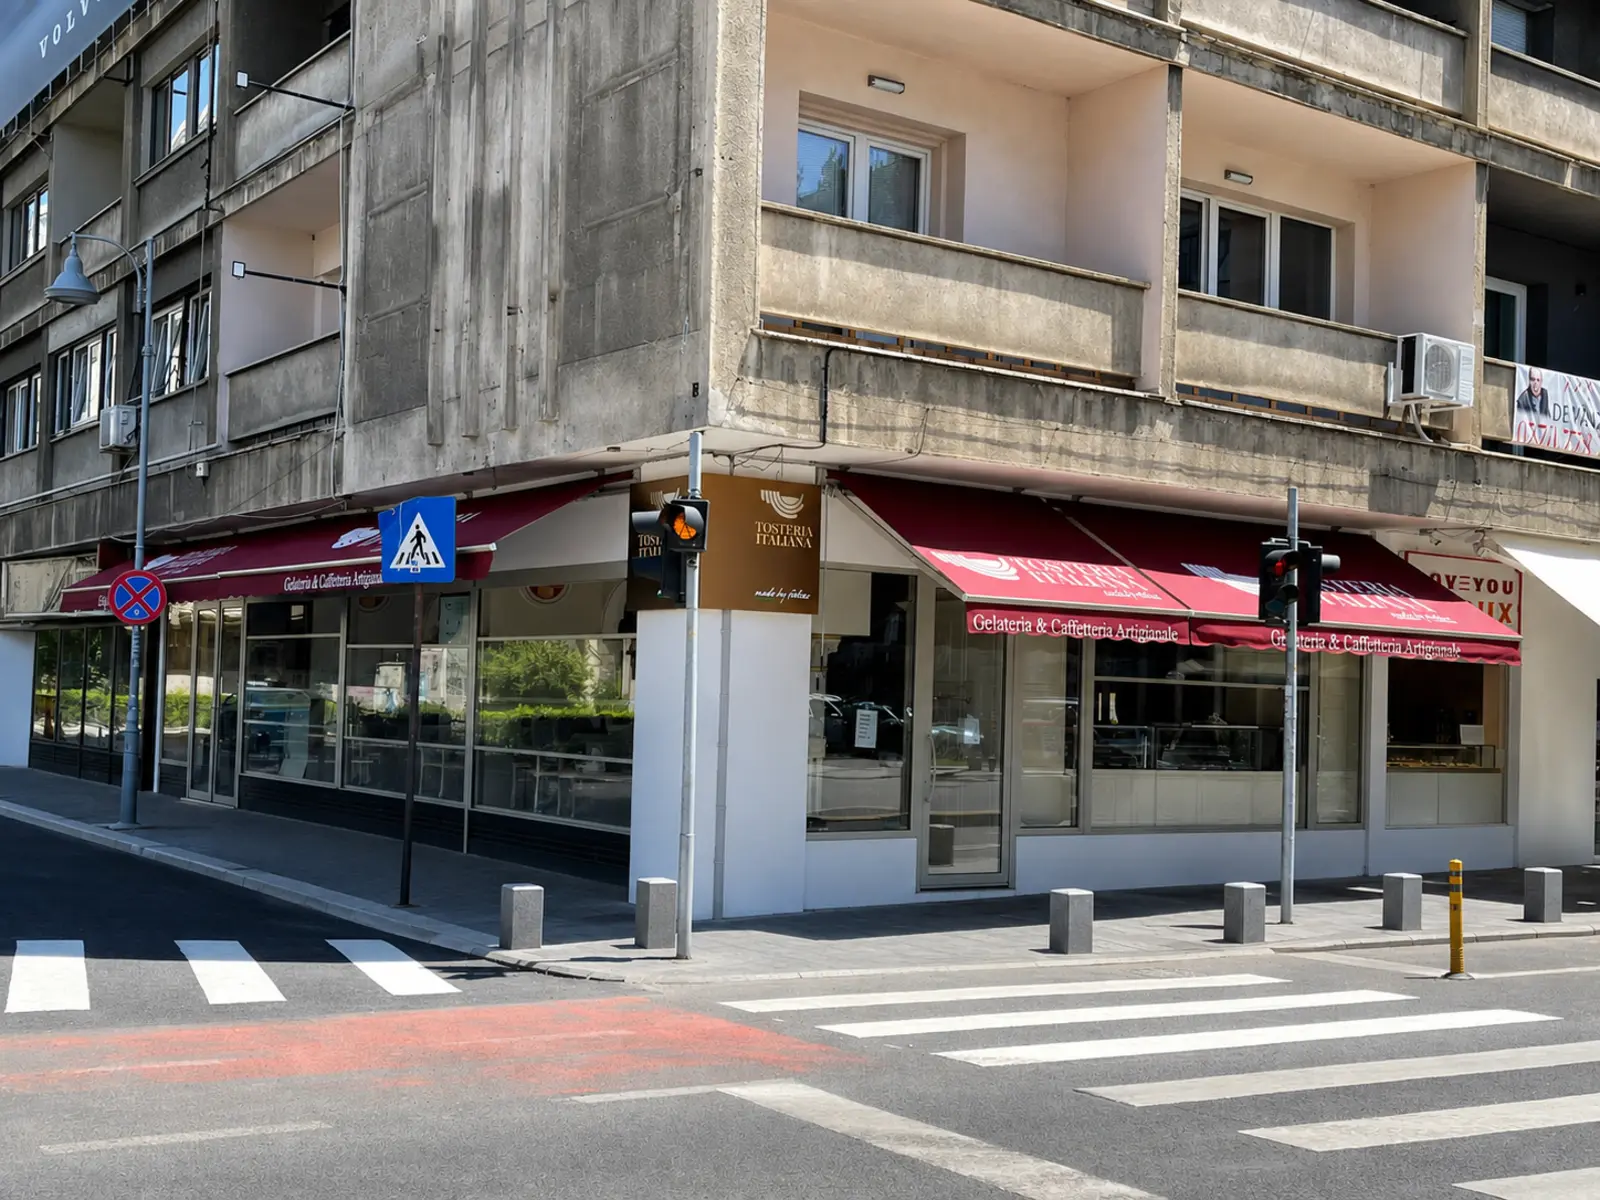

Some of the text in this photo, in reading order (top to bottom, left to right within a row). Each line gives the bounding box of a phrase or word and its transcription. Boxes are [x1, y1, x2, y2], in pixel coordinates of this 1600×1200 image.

[39, 0, 101, 58] VOLV
[1552, 402, 1569, 423] DE
[755, 521, 813, 537] TOSTERIA
[756, 533, 812, 548] ITALIANA
[1009, 557, 1134, 579] TOSTERIA
[1028, 571, 1148, 591] ITALIANA
[1320, 580, 1415, 599] STERIA
[1320, 591, 1437, 613] TALIANA
[973, 614, 1179, 643] Gelateria & Caffetteria Artigianale
[1271, 629, 1462, 660] Geateria & Caffetteria Artigianale
